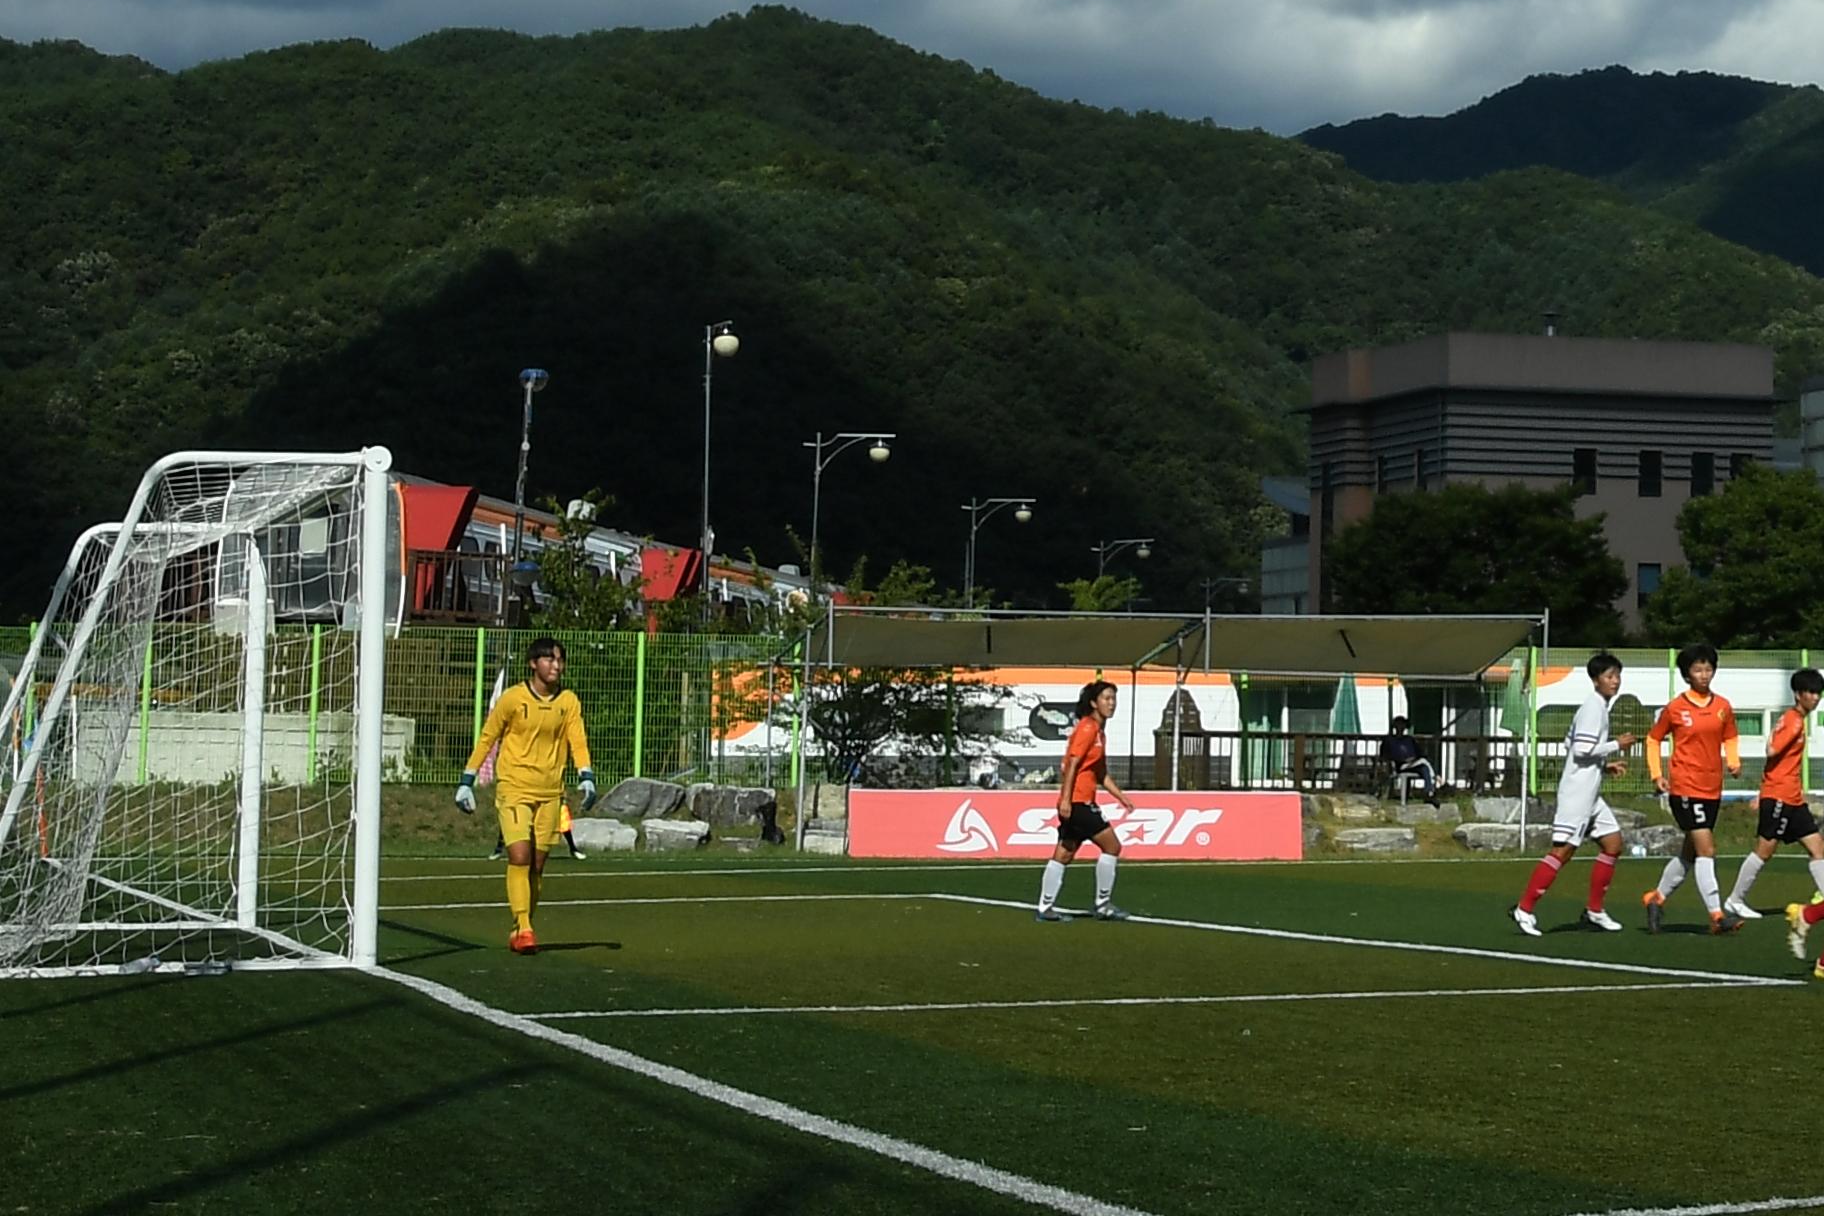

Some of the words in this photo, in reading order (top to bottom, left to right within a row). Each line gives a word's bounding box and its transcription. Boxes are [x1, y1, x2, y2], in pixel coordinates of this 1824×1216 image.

[1680, 710, 1693, 727] 5
[1692, 803, 1707, 823] 5
[1006, 802, 1223, 846] sar
[1776, 817, 1789, 835] 3
